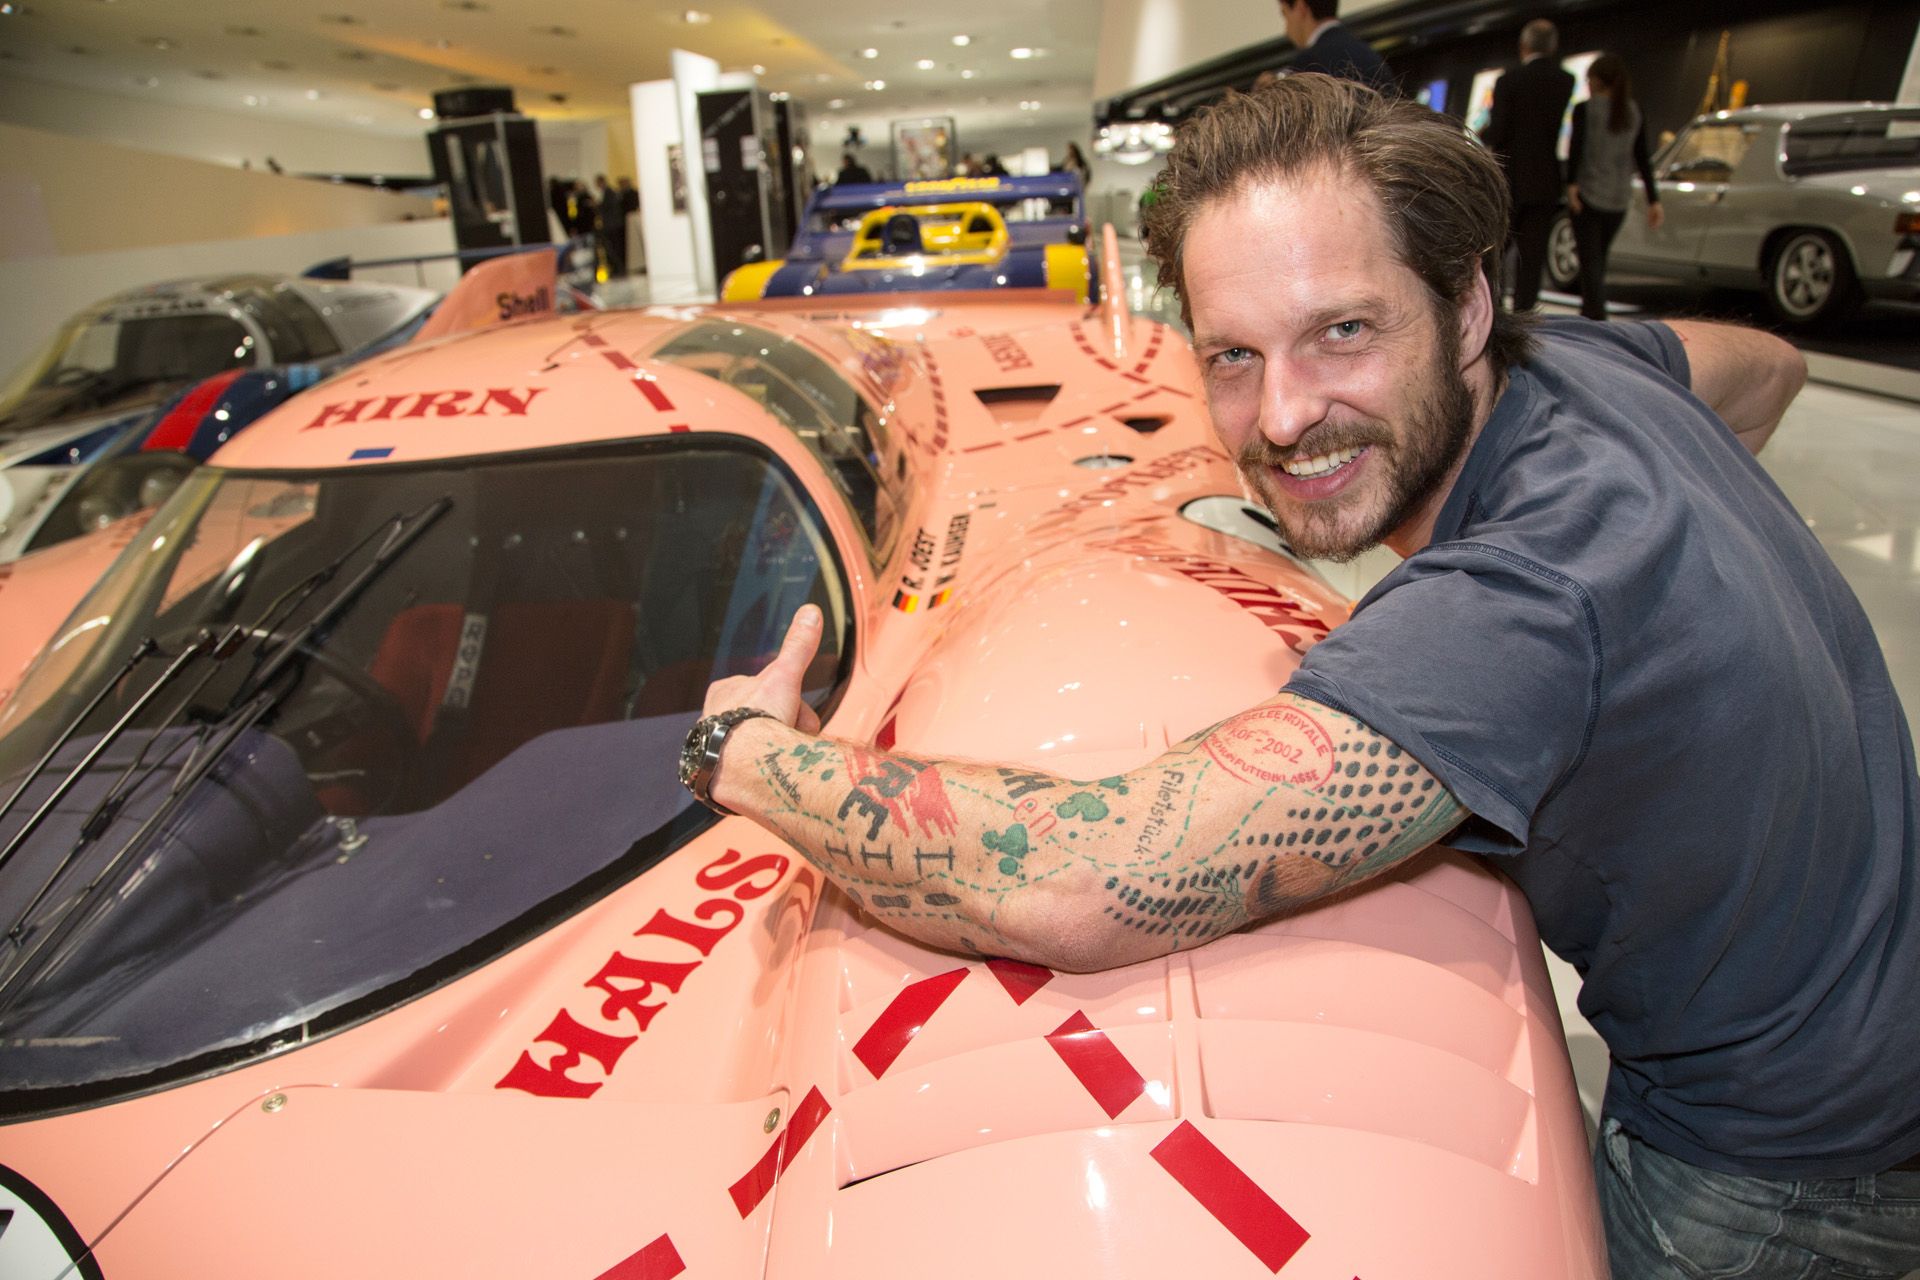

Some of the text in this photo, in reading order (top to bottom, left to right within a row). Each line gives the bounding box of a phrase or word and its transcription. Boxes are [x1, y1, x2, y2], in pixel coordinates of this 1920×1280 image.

[300, 387, 549, 432] HIRN
[911, 527, 936, 571] JOEST
[1262, 737, 1303, 764] 2002
[1284, 712, 1329, 758] ROYALE
[1134, 769, 1184, 855] Filetstück
[494, 848, 790, 1099] HALS
